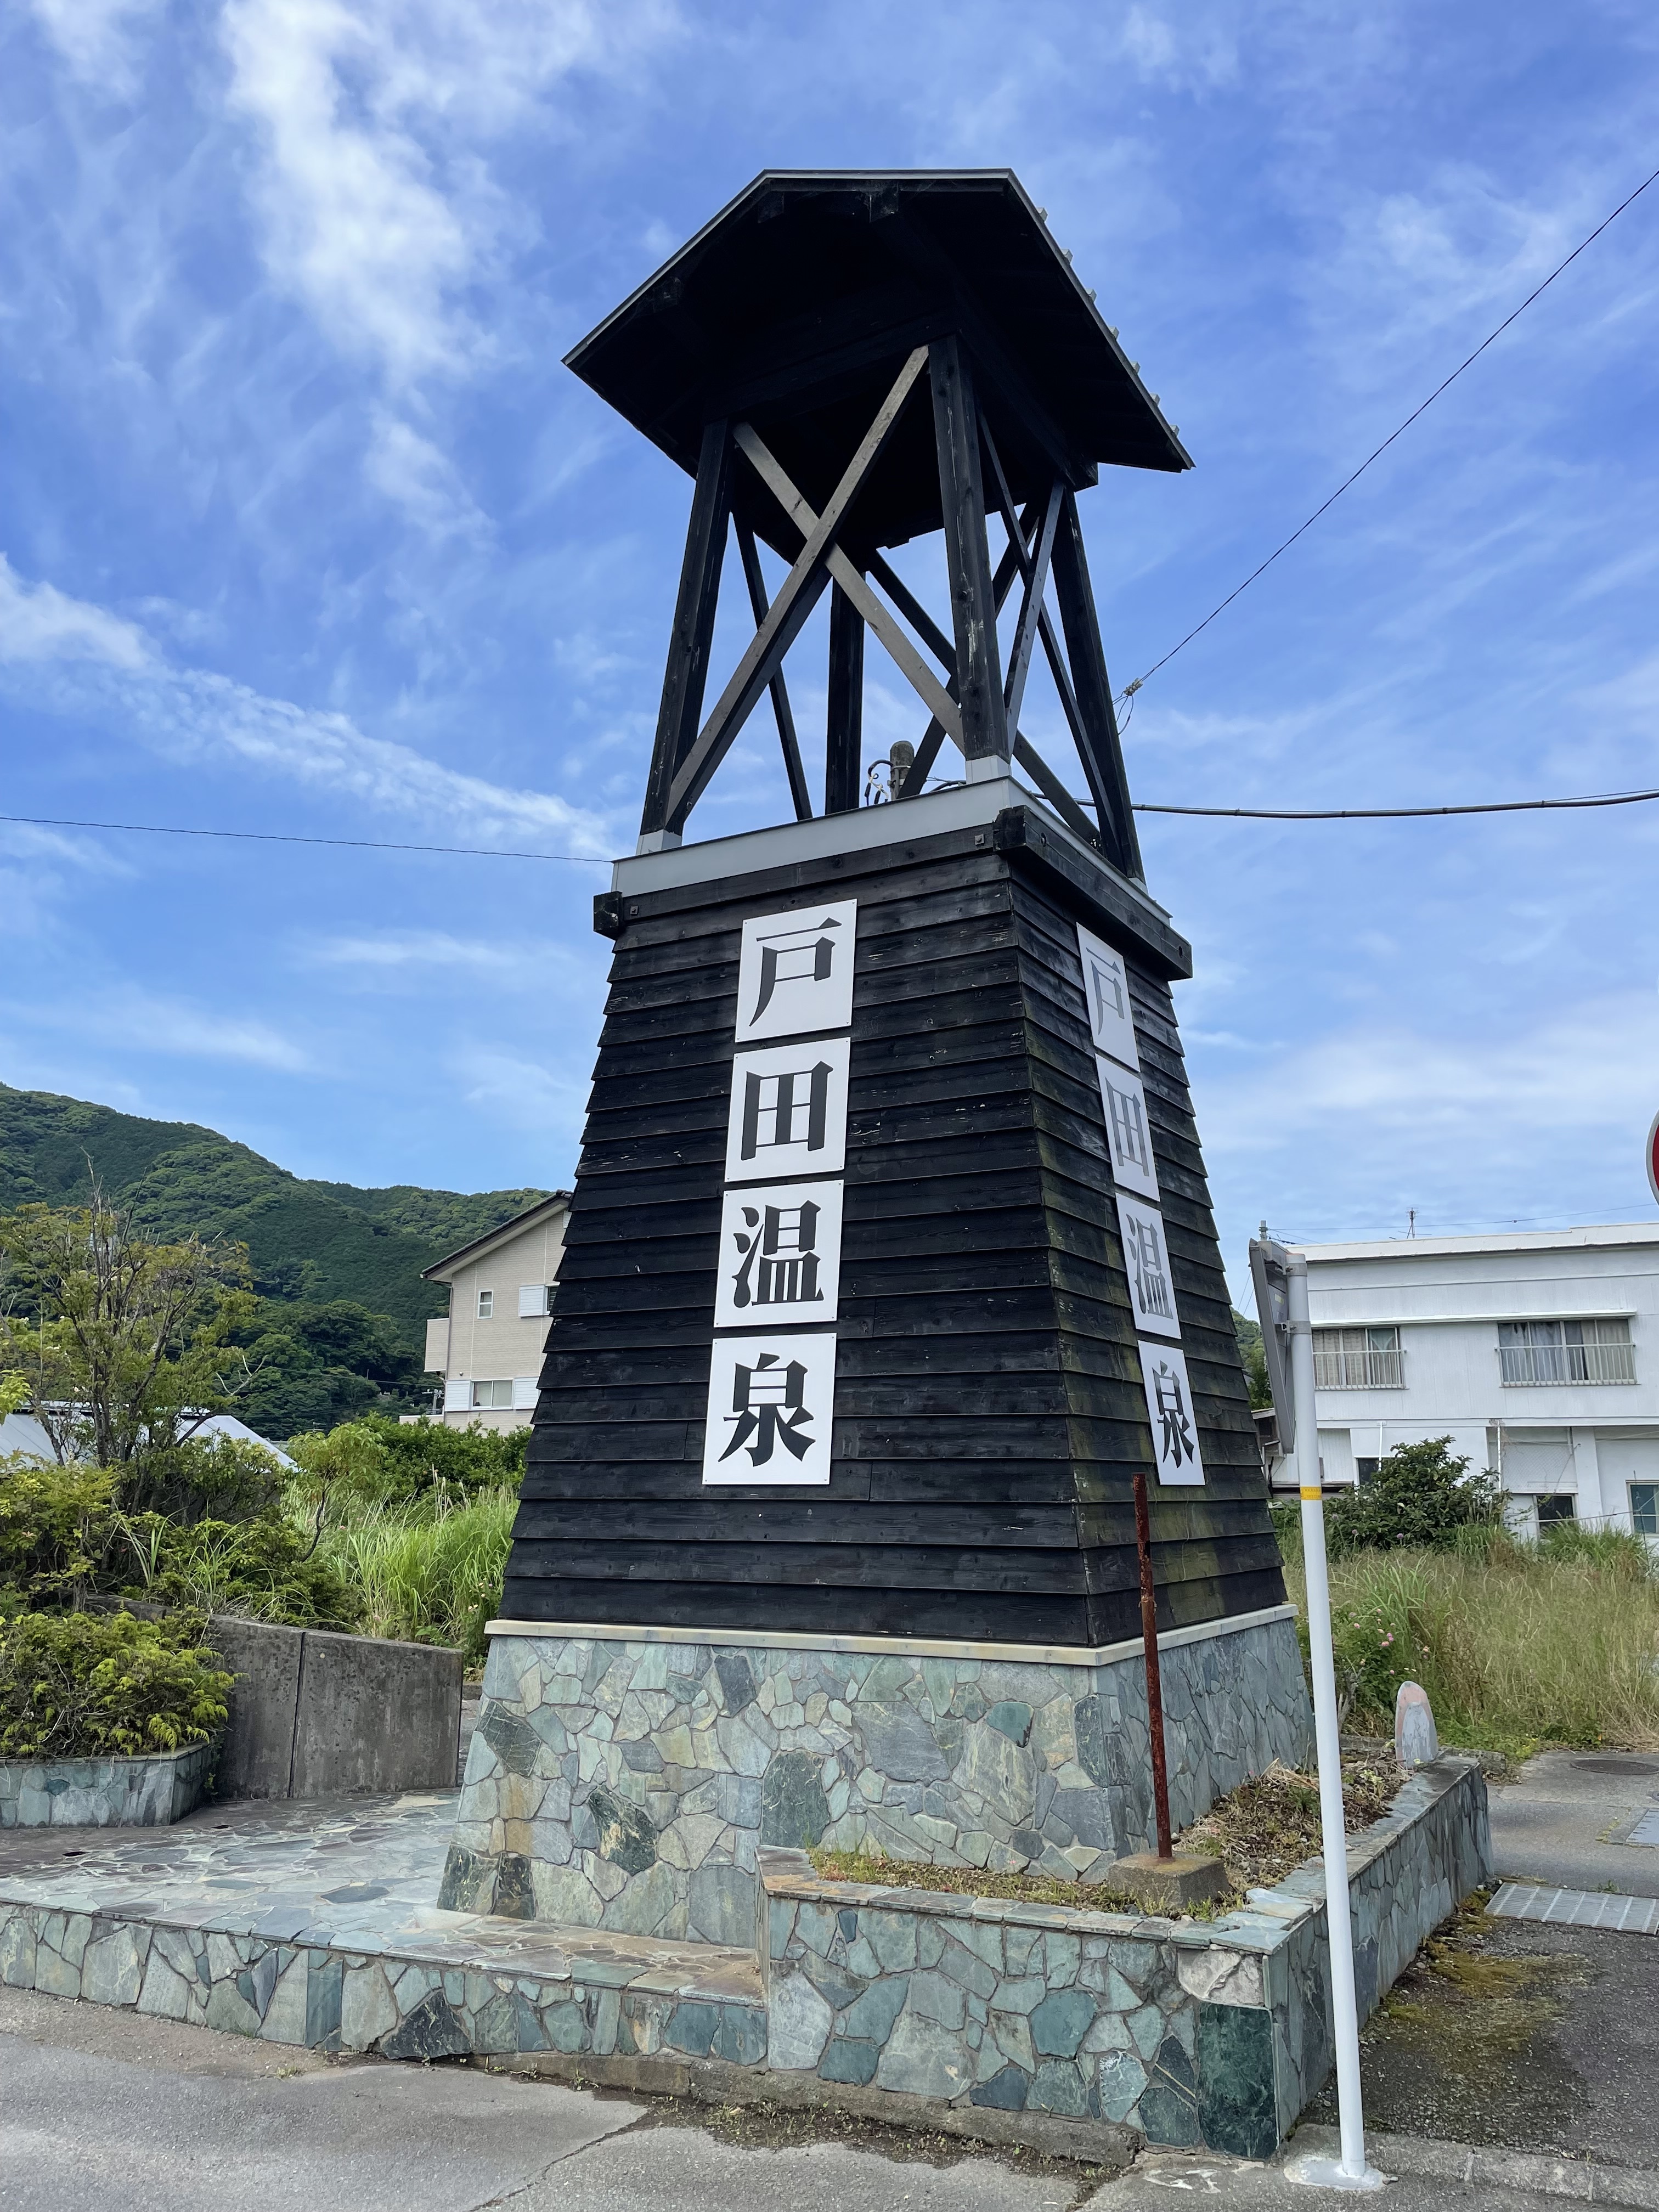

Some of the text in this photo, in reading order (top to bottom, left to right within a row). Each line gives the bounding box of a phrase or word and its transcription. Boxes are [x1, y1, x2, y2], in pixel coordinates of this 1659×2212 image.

[718, 917, 842, 1468] 戸田温泉
[1086, 947, 1194, 1469] 戸田温泉
